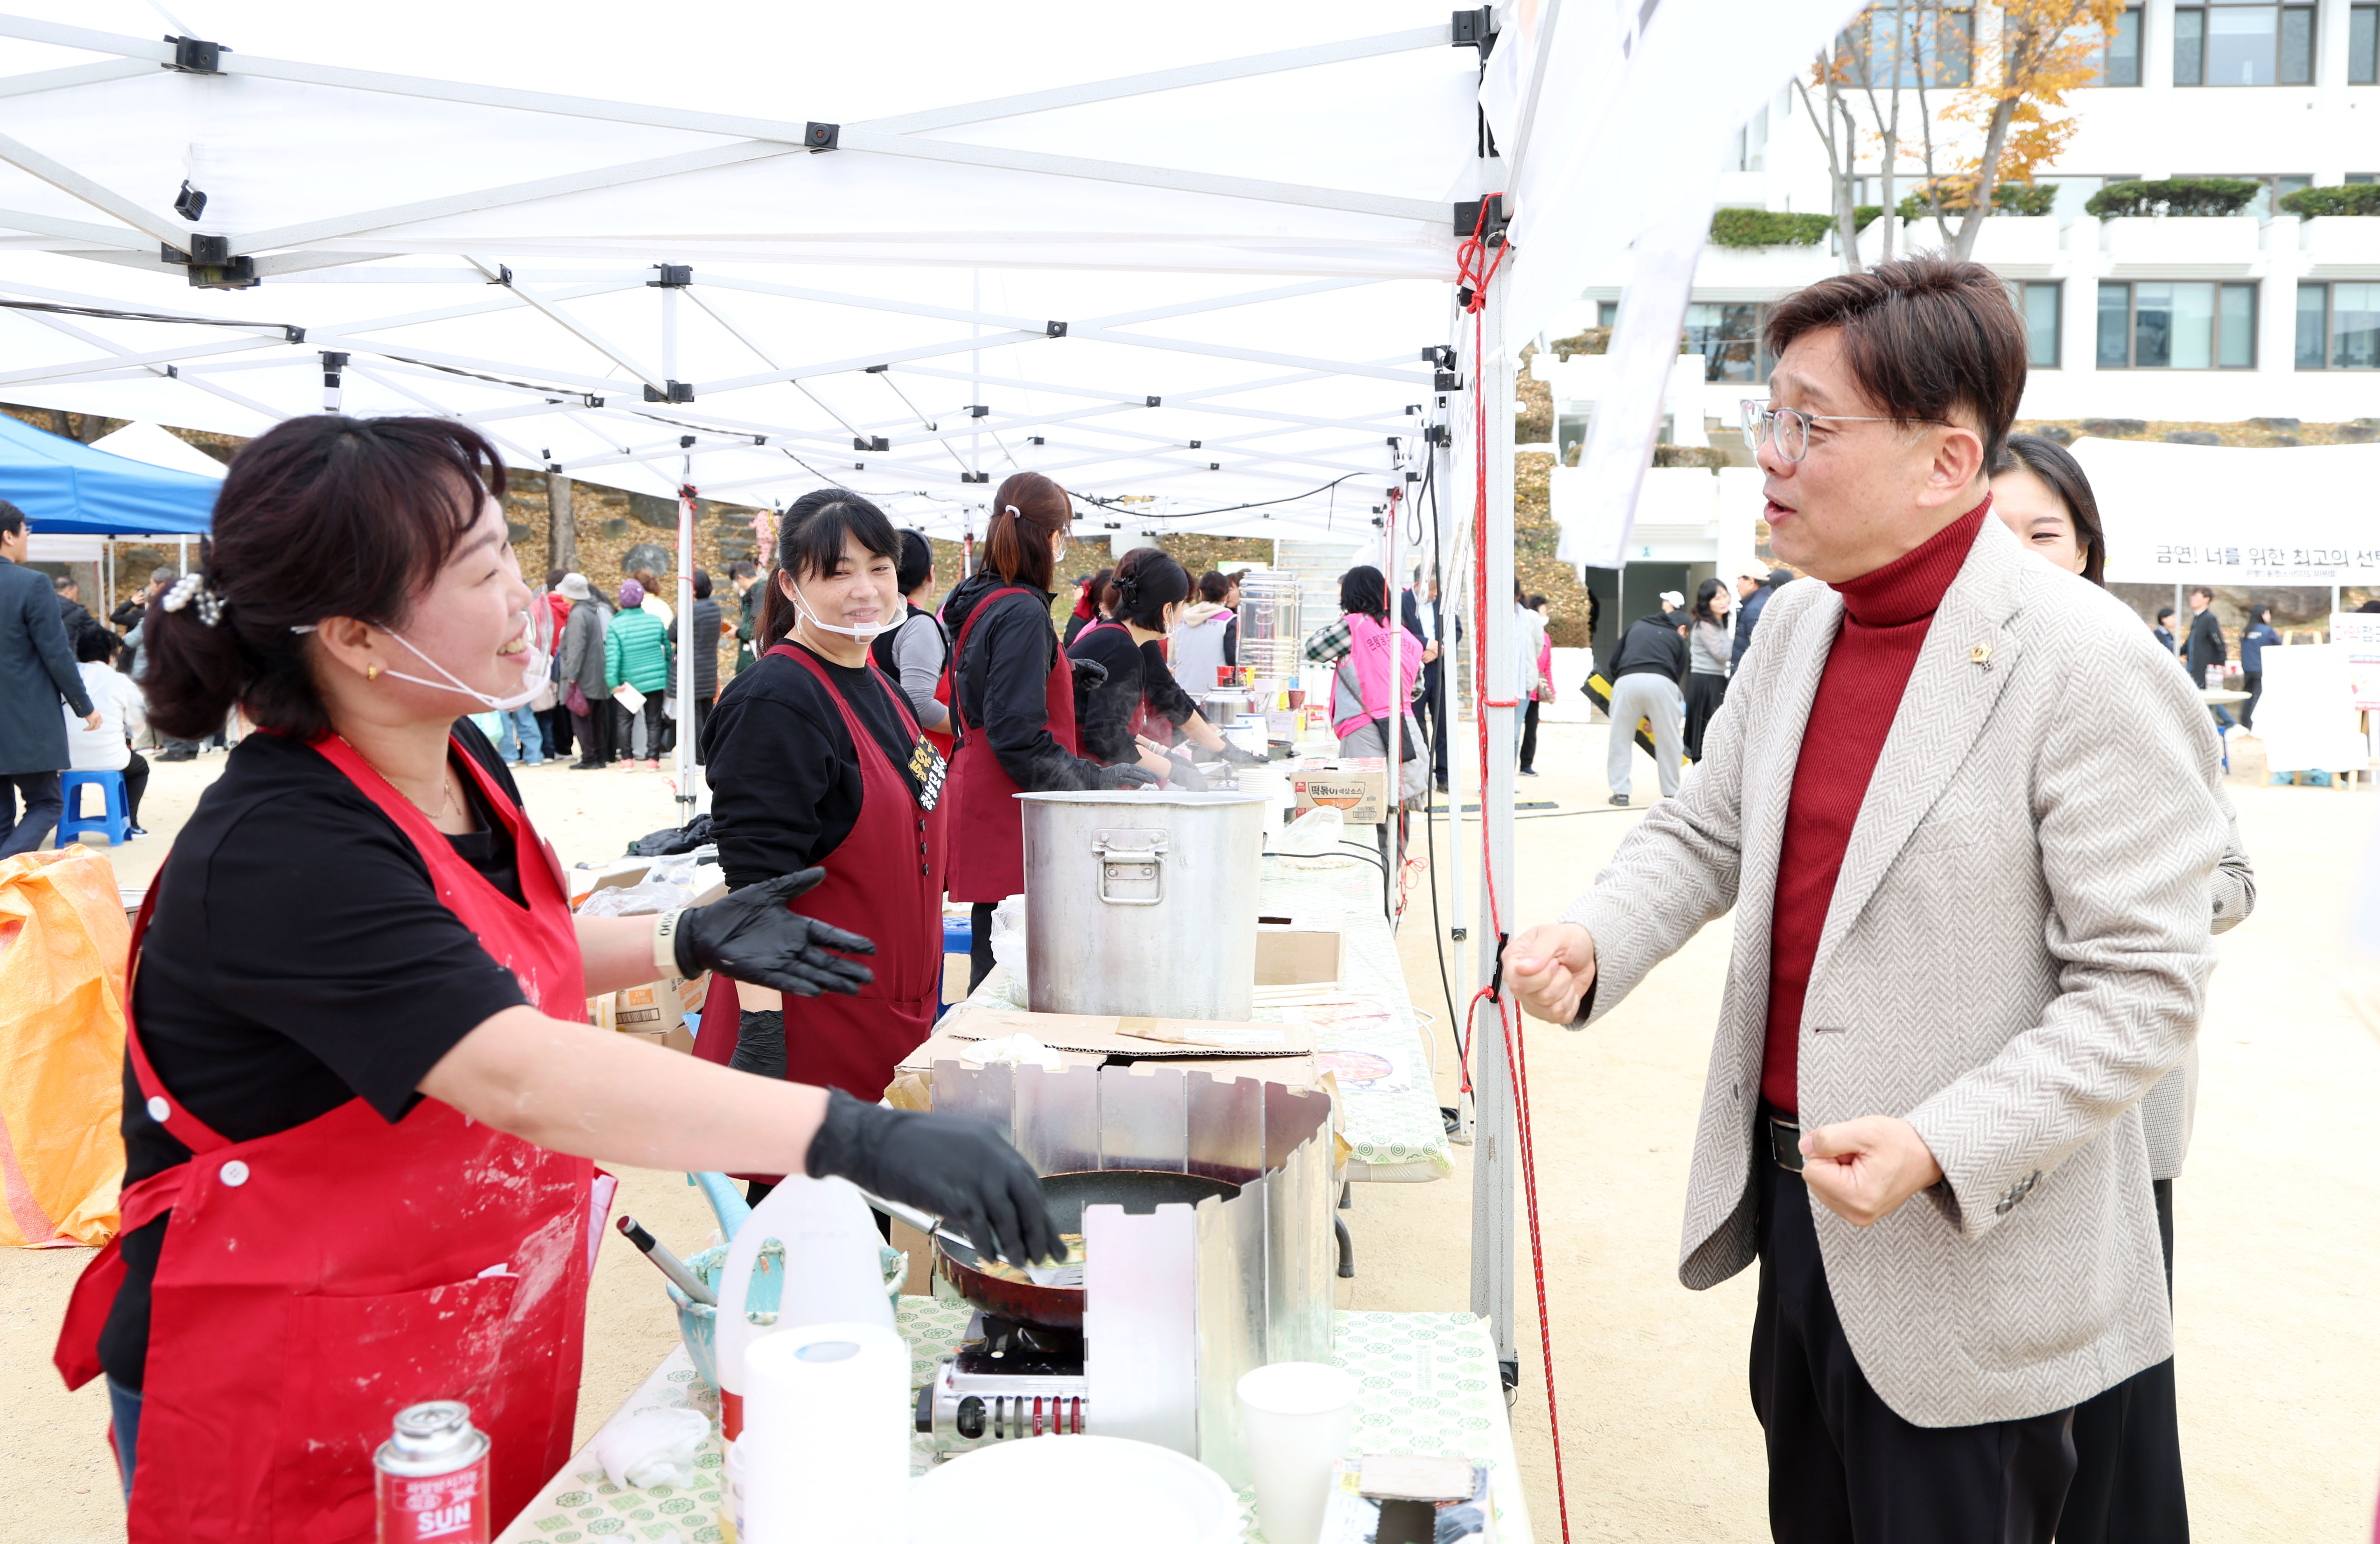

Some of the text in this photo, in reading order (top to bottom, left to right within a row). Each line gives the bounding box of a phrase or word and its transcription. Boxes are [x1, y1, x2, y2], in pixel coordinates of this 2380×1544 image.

[2156, 545, 2380, 567] 금연! 너를 위한 최고의 선
[909, 734, 935, 782] 중원구
[1311, 785, 1338, 796] 떡볶이
[417, 1501, 471, 1533] SUN
